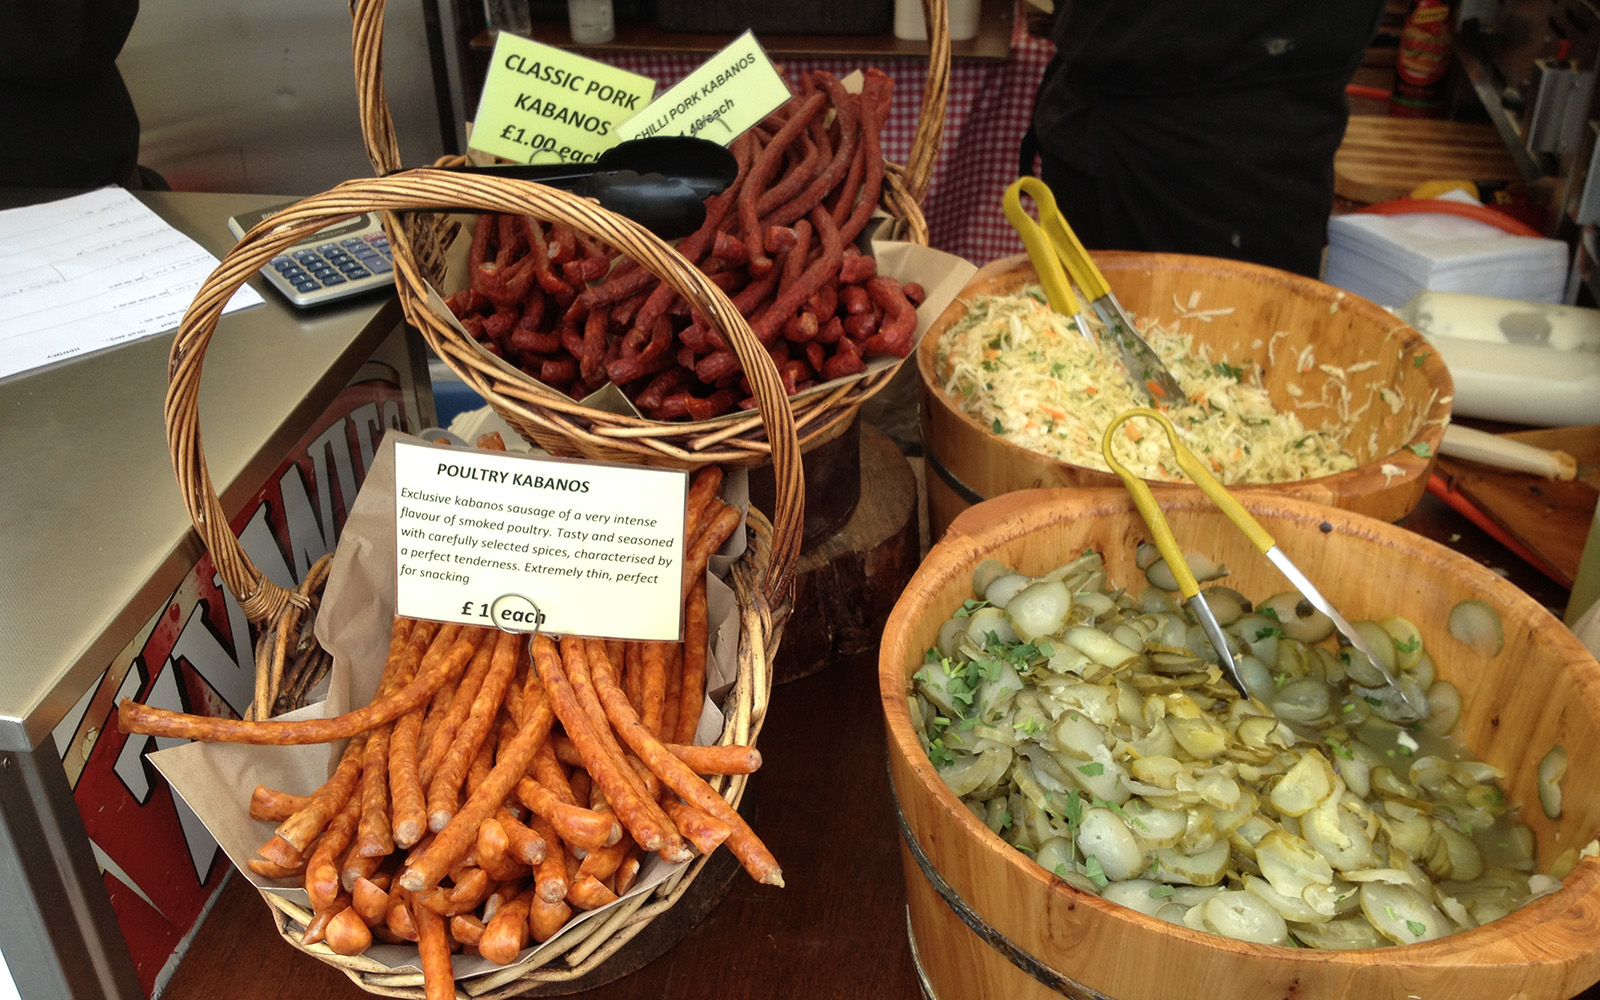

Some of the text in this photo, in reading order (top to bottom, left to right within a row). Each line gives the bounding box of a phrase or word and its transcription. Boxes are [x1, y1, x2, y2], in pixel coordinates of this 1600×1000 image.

[505, 54, 641, 111] CLASSIC PORK
[634, 52, 756, 140] CHILLI PORK KABANOS
[514, 93, 612, 136] KABANOS
[500, 125, 557, 153] £1.00
[437, 463, 590, 493] POULTRY KABANOS
[399, 506, 674, 548] flavour of smoked poultry. Tasty and seasoned
[401, 487, 657, 527] Exclusive kabanos sausage of a very intense
[400, 547, 658, 585] a perfect tenderness. Extremely thin, perfect
[401, 528, 673, 568] with carefully selected spices, characterised by
[399, 564, 470, 585] for snacking
[461, 601, 546, 625] £ 1 each
